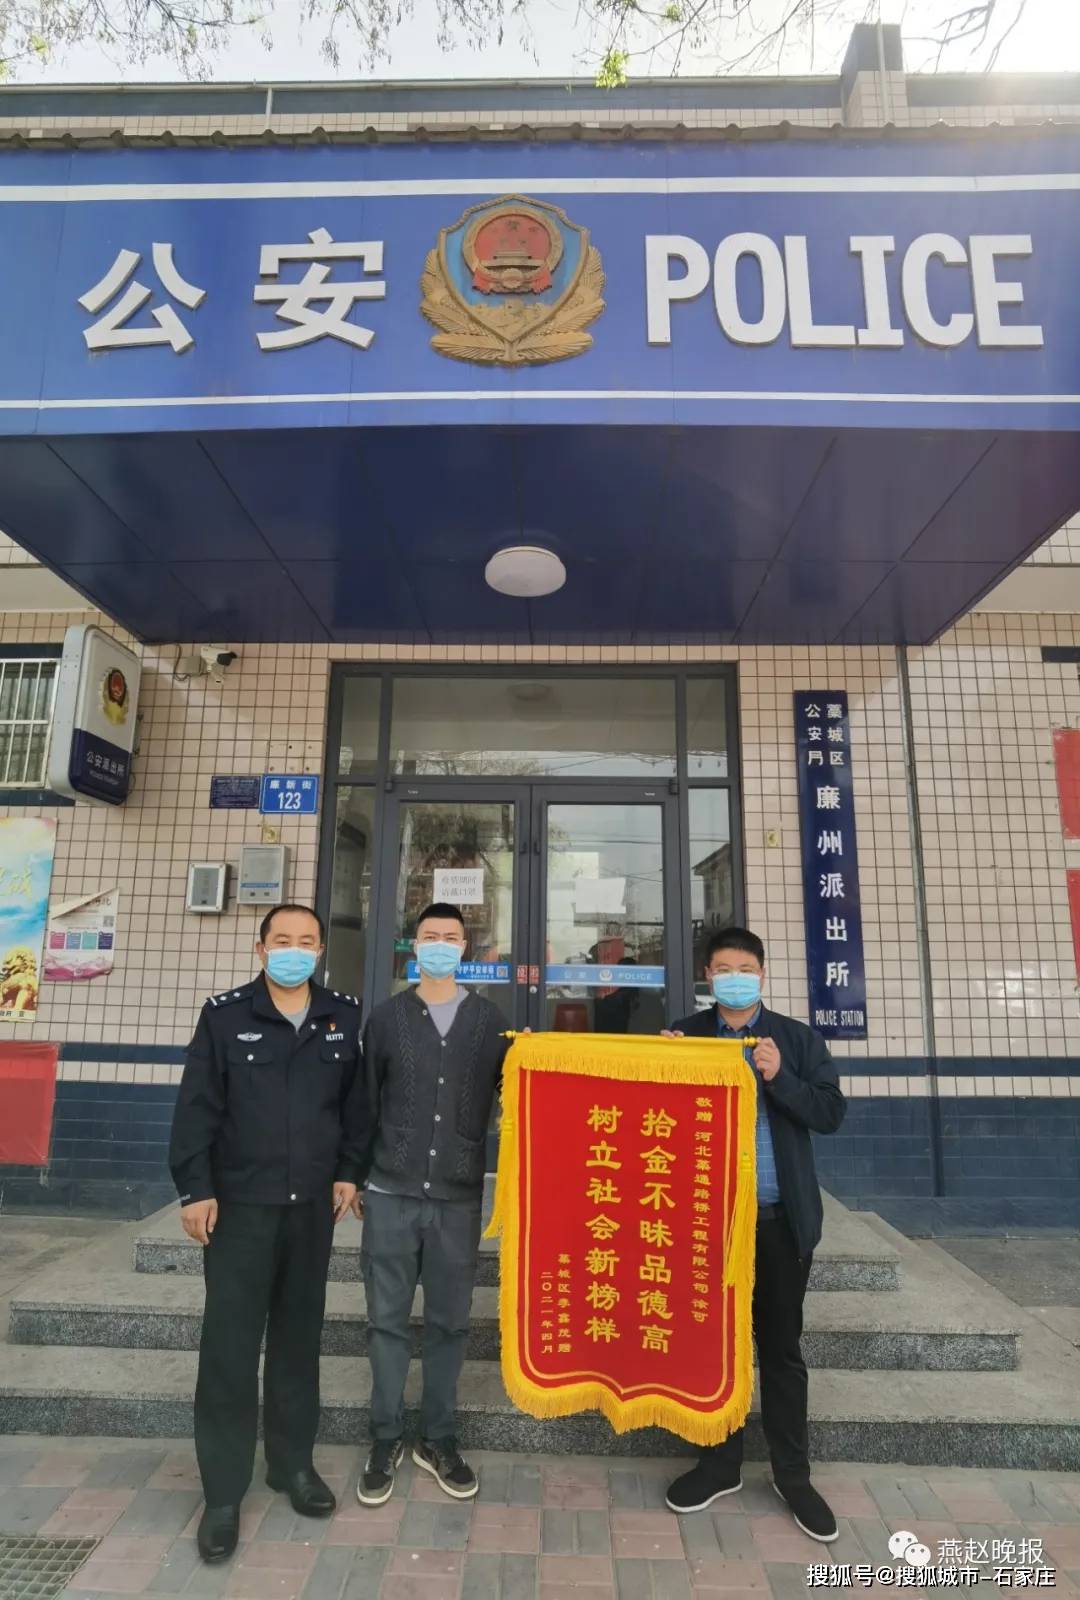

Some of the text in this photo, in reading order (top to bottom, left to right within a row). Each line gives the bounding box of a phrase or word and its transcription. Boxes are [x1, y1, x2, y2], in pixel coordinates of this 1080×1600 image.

[78, 228, 387, 354] 公安
[645, 232, 1044, 350] POLICE
[278, 792, 302, 810] 123
[816, 785, 849, 987] 廉州派出所
[815, 1010, 864, 1026] POLICE STATION
[695, 1097, 713, 1122] 敬赠
[584, 1103, 622, 1344] 树立社会新榜样
[637, 1107, 677, 1354] 拾金不昧品德高
